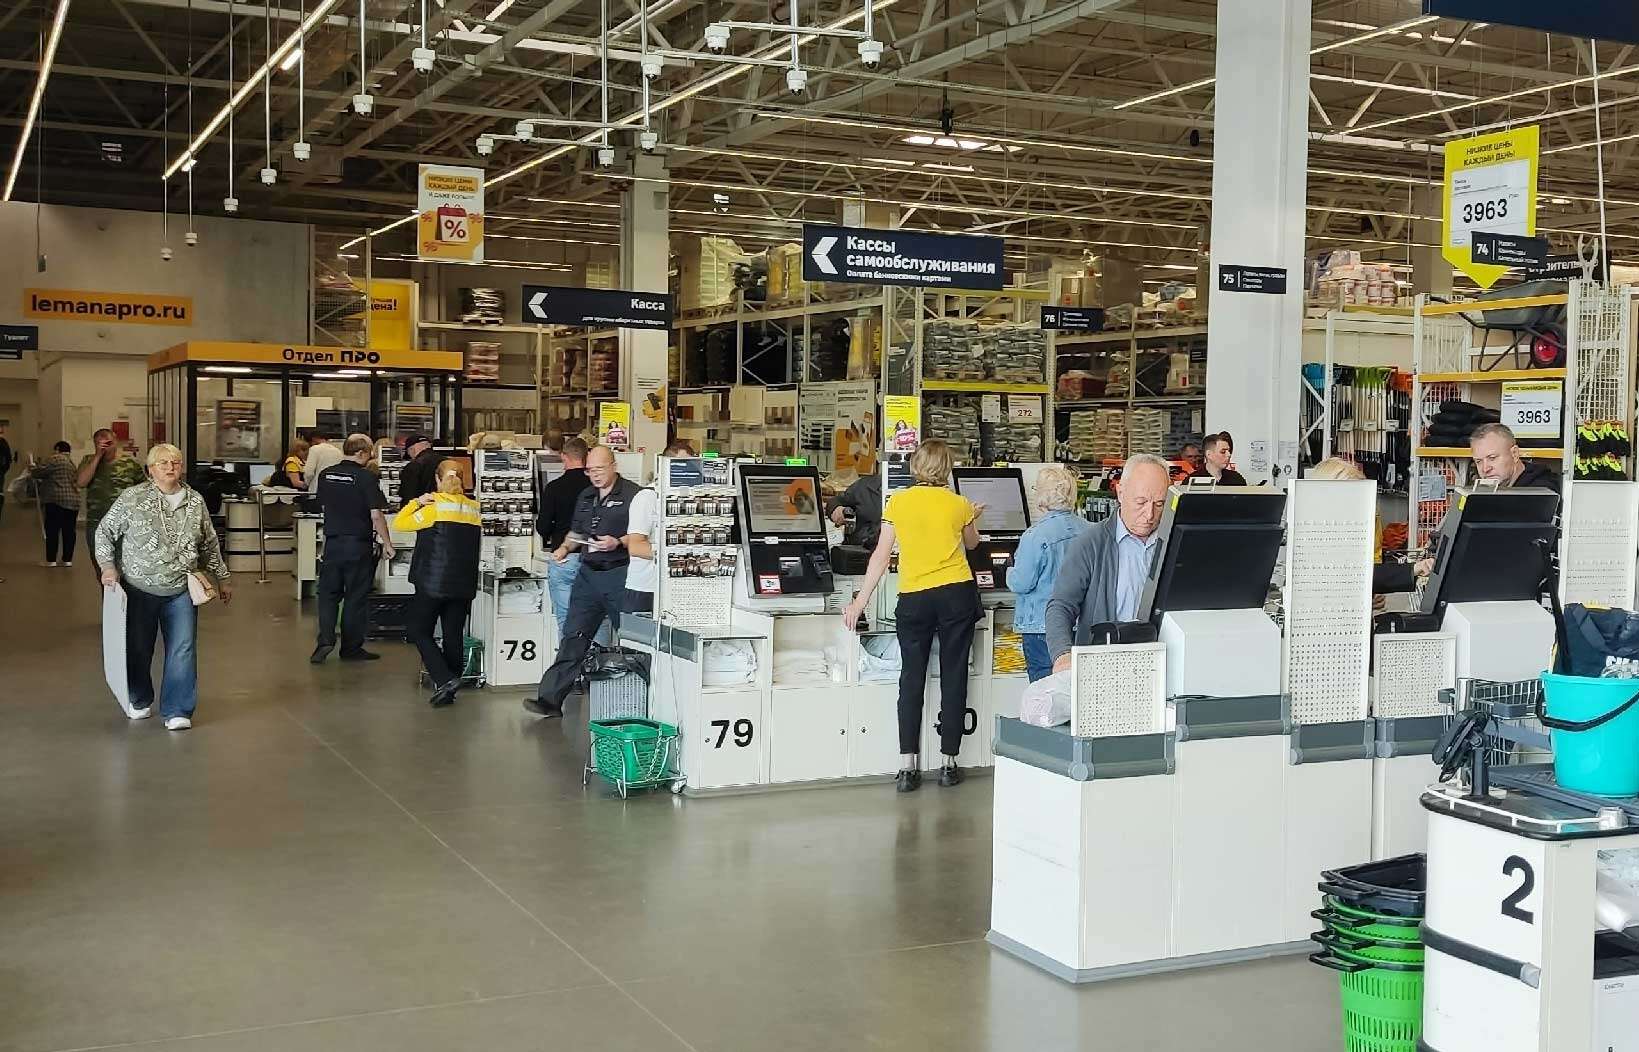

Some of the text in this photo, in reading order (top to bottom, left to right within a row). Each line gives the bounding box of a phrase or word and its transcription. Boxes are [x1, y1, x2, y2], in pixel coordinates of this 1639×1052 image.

[1463, 199, 1508, 223] 3963
[846, 236, 896, 254] Кассы
[1476, 243, 1489, 255] 74
[846, 253, 996, 275] самообслуживания
[1222, 273, 1235, 284] 75
[31, 294, 186, 320] lemanapro.ru
[631, 298, 666, 311] Касса
[1044, 314, 1056, 324] 76
[282, 348, 381, 364] Отдел ПРО
[1517, 409, 1551, 424] 3963
[502, 639, 537, 662] 78
[936, 707, 978, 735] 0
[710, 718, 754, 749] 79
[1501, 854, 1535, 925] 2
